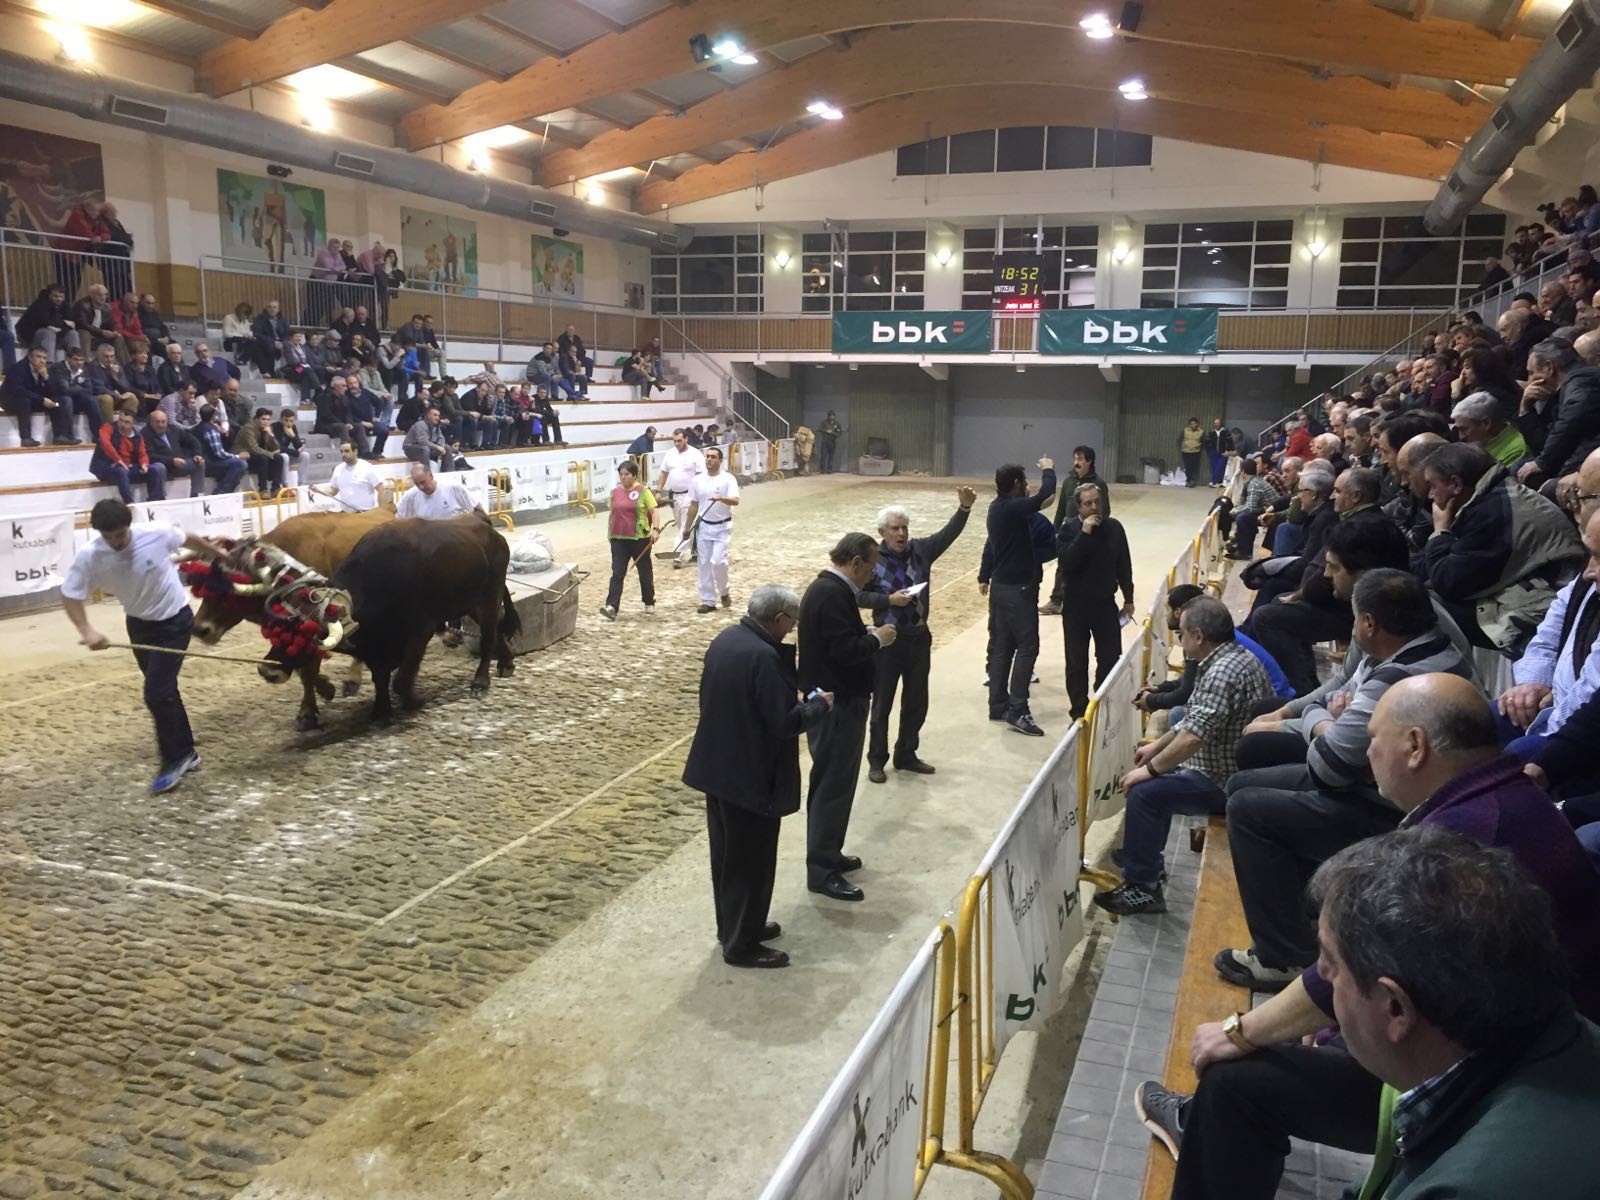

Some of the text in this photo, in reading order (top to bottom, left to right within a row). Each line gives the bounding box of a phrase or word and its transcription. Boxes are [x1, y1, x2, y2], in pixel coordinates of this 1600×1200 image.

[1001, 267, 1039, 280] 18:52
[1020, 283, 1038, 296] 31
[872, 321, 948, 343] bbk
[1083, 320, 1168, 343] bbk
